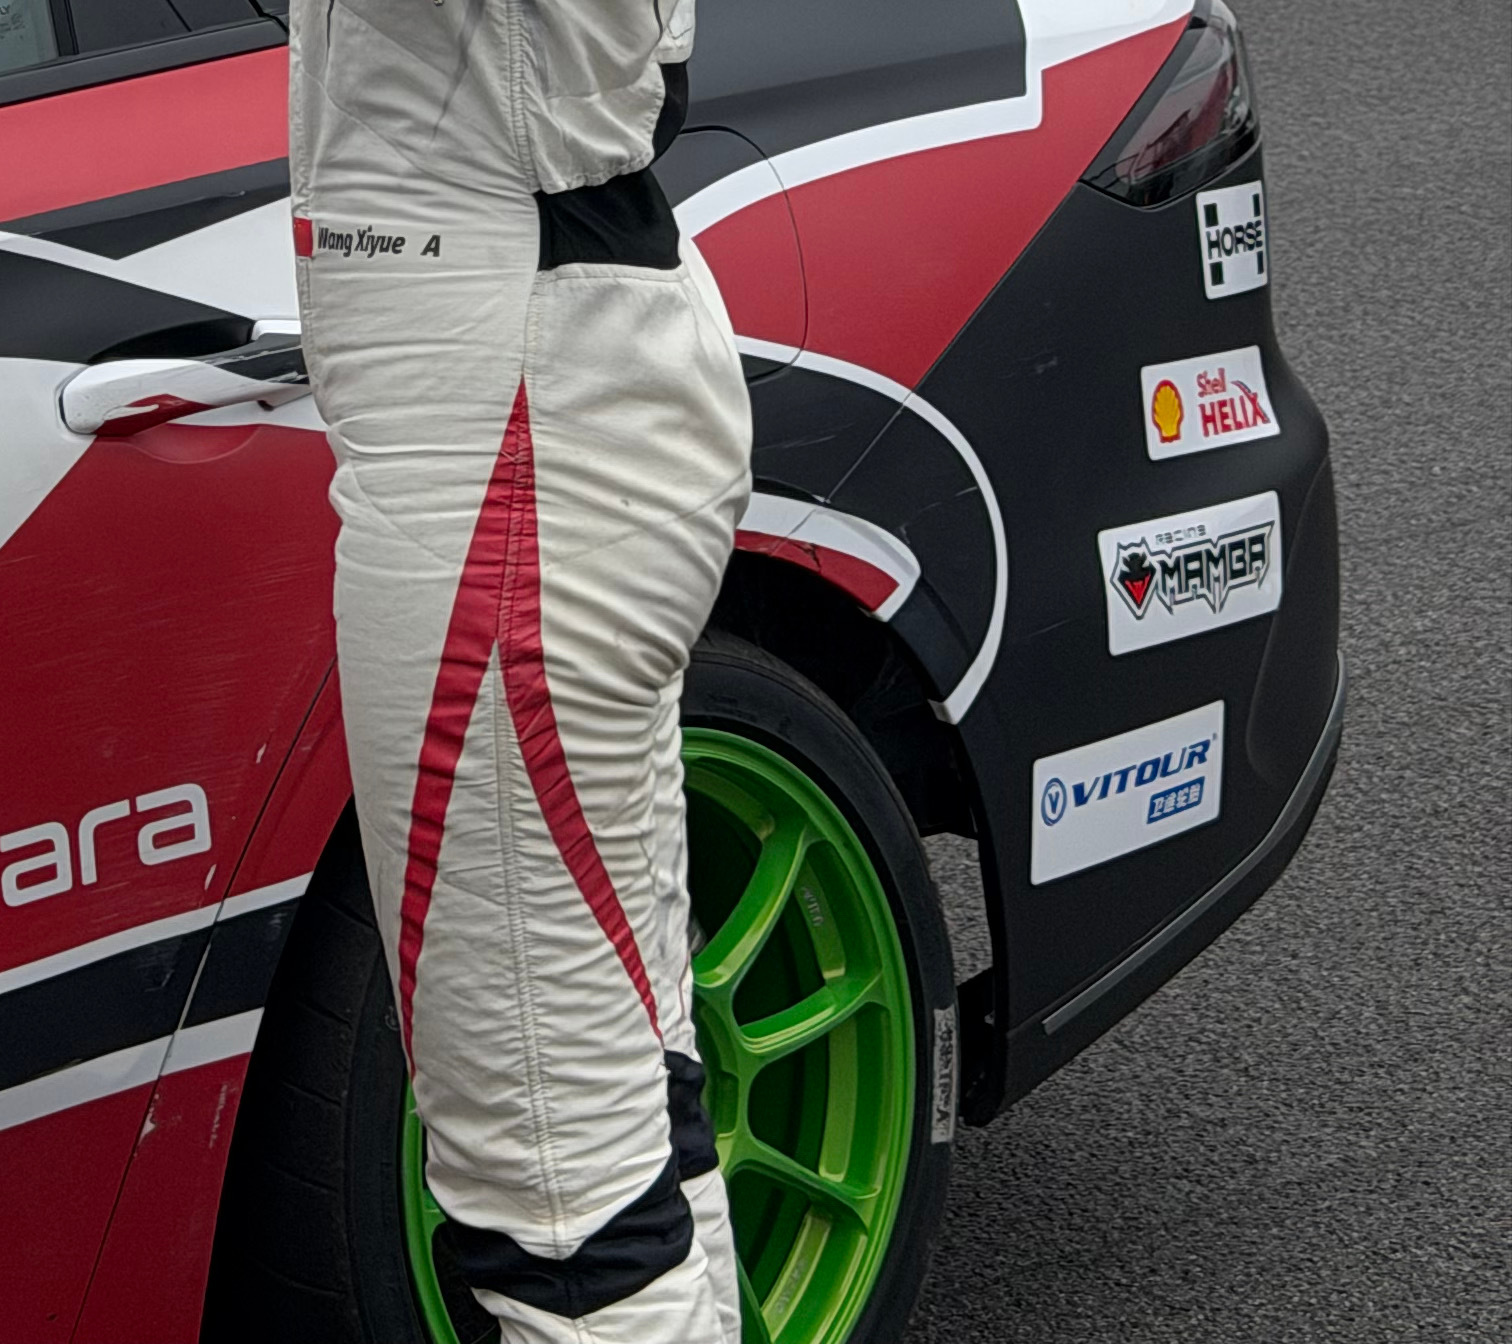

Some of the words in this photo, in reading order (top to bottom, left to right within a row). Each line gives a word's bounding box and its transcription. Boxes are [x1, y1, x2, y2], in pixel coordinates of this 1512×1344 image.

[317, 226, 354, 258] Wang
[353, 225, 406, 259] Xiyue
[419, 234, 442, 258] A
[1204, 220, 1264, 261] HORSE
[1196, 367, 1227, 398] Shell
[1198, 384, 1271, 437] HELIX
[1071, 738, 1212, 808] VITOUR
